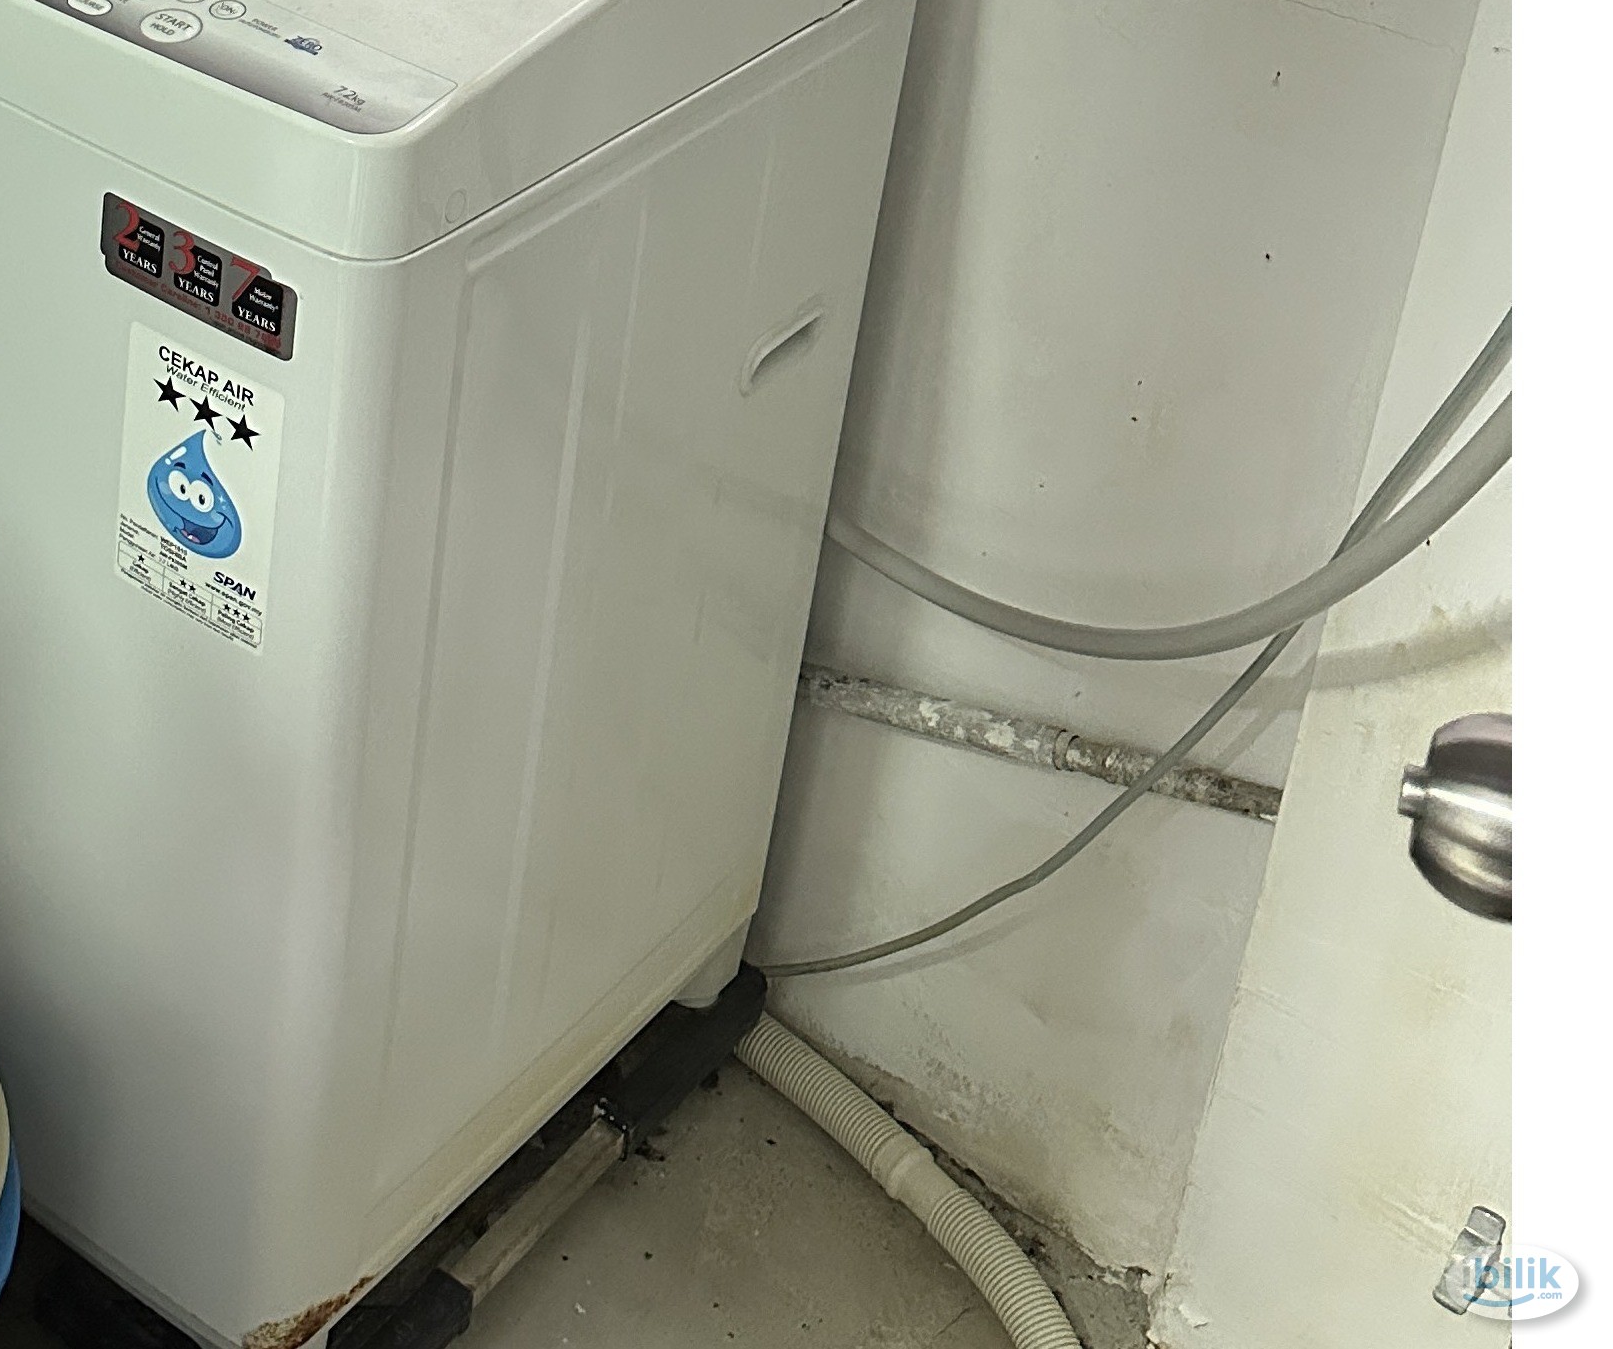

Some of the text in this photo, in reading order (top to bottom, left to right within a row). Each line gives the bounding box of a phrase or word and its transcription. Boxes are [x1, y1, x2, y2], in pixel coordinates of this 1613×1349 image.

[150, 22, 175, 36] HOLD
[155, 13, 193, 32] START
[333, 85, 366, 105] 7.2kg
[112, 200, 140, 252] 2
[139, 225, 160, 242] General
[137, 232, 161, 252] Warranty
[169, 230, 196, 274] 3
[122, 248, 158, 274] YEARS
[197, 254, 219, 270] Control
[200, 264, 215, 277] Panel
[178, 276, 214, 303] YEARS
[193, 270, 219, 289] Warranty
[230, 254, 261, 300] 7
[254, 286, 272, 300] Motor
[237, 305, 276, 332] YEARS
[159, 345, 254, 407] CEKAP AIR
[166, 364, 247, 412] Water Efficient
[213, 571, 256, 601] SPAN
[205, 582, 263, 617] www.span.gov.my
